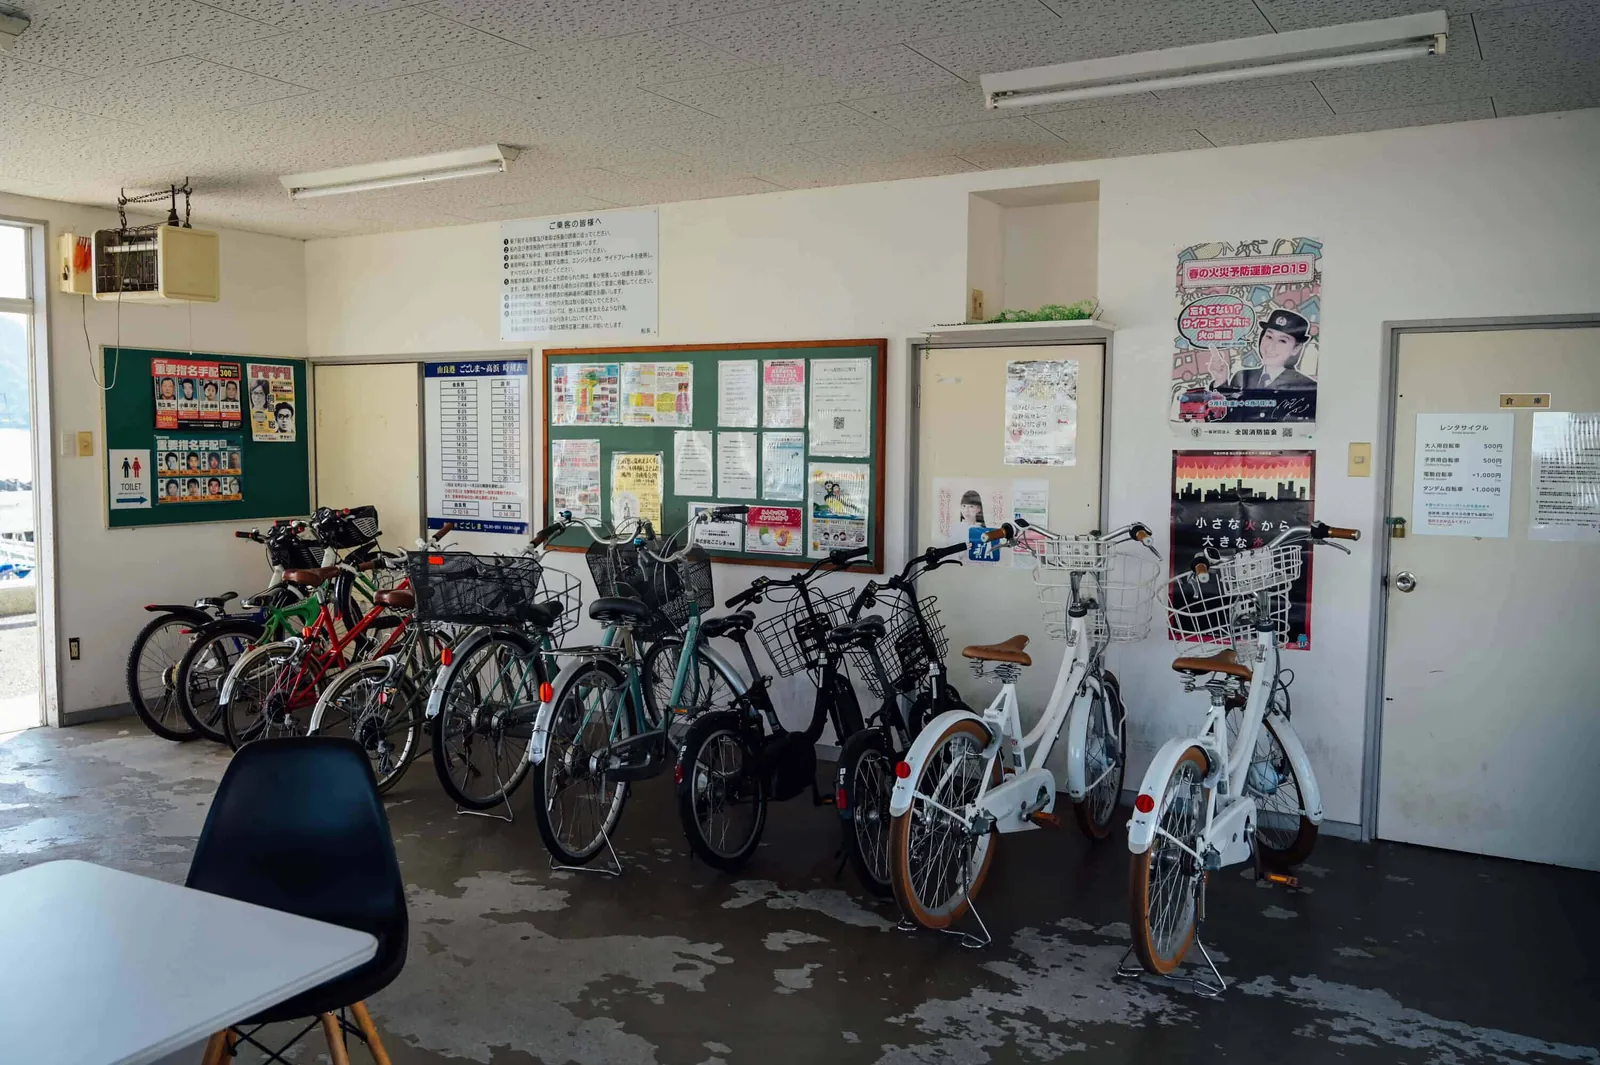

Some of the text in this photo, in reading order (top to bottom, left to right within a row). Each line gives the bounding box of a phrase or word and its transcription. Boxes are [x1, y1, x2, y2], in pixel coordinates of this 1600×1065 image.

[549, 218, 602, 230] ご乗客の皆様へ
[1188, 263, 1308, 280] 春の火災予防運動2019
[1182, 317, 1250, 329] サイフにスマホに
[155, 363, 219, 378] 重要指名手配
[157, 440, 219, 450] 重要指名手配
[1196, 516, 1290, 532] 小さな火から
